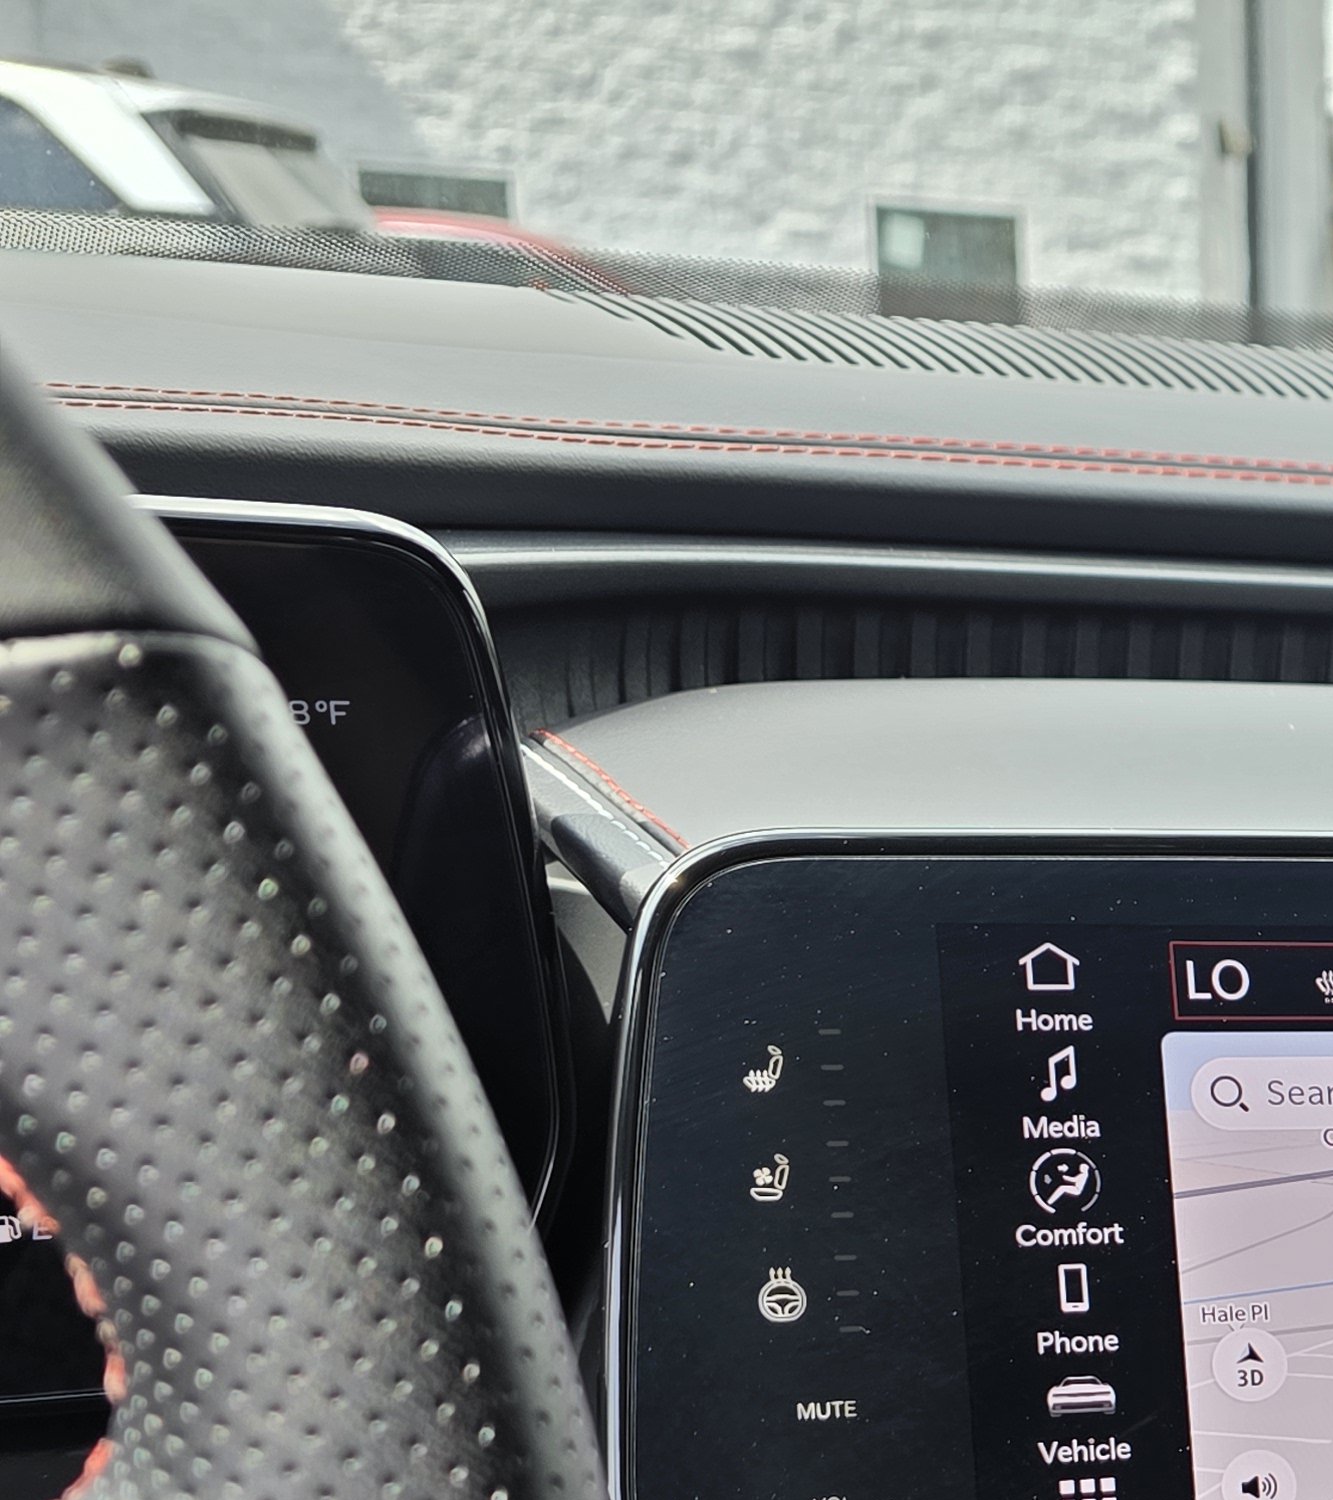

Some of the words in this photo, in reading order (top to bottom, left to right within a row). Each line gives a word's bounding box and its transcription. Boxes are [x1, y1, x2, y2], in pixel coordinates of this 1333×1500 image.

[1184, 958, 1251, 1002] LO
[1016, 1009, 1094, 1031] Home
[1022, 1115, 1101, 1139] Media
[1016, 1223, 1124, 1246] Comfort
[1200, 1305, 1245, 1324] Hale
[1036, 1331, 1119, 1355] Phone
[1237, 1369, 1264, 1388] 3D
[796, 1400, 857, 1420] MUTE
[1037, 1437, 1131, 1462] Vehicle
